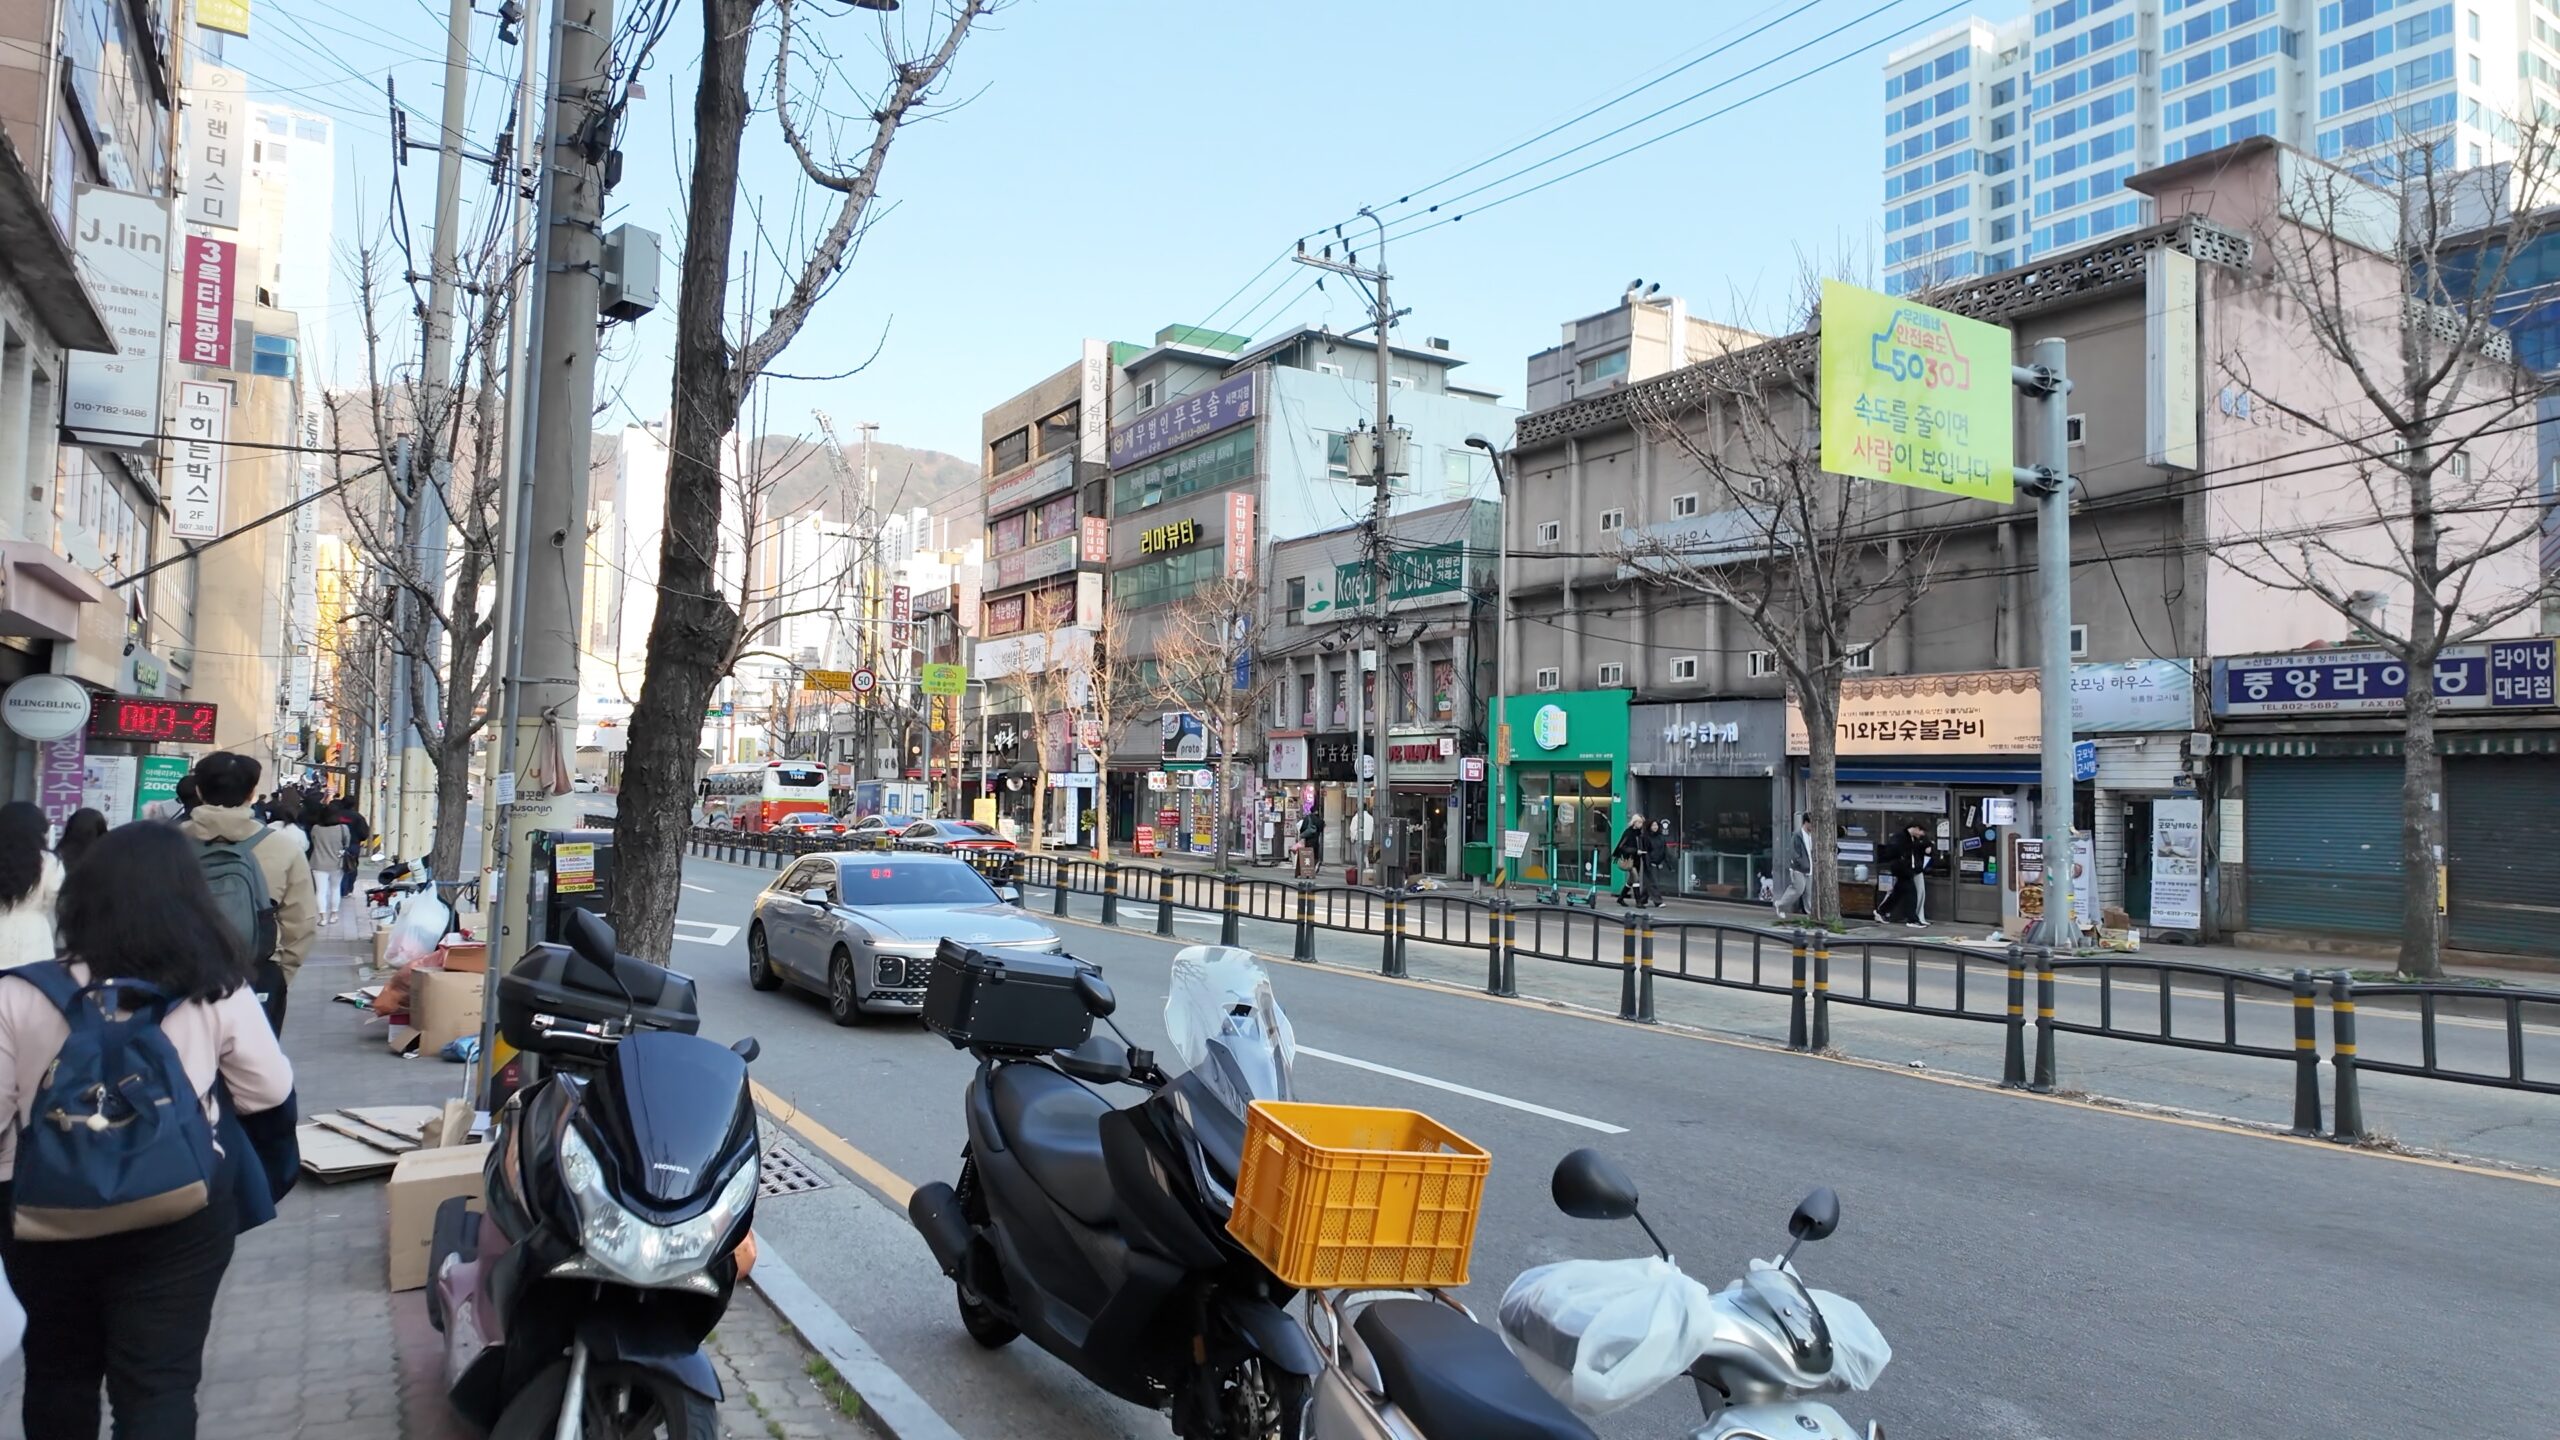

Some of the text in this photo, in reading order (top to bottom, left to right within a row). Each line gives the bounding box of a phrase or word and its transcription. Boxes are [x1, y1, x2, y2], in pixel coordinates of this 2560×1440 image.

[80, 218, 162, 254] J.lin
[1896, 324, 1948, 355] 안전속도
[1892, 349, 1955, 389] 5030
[1125, 412, 1169, 448] 세무법인
[1173, 390, 1221, 431] 푸른솔
[1853, 392, 1969, 447] 속도를 줄이면
[186, 417, 212, 503] 히든박스
[1853, 435, 1991, 486] 사람이 보입니다
[189, 510, 204, 519] 2F
[1141, 518, 1194, 554] 리마뷰티
[1403, 555, 1434, 590] Club
[2495, 647, 2550, 670] 라이닝
[858, 676, 870, 686] 50
[2111, 675, 2154, 690] 하우스
[2496, 676, 2551, 699] 대리점
[9, 699, 82, 710] BLINGBLING
[1664, 721, 1739, 749] 기억하개
[1838, 719, 1985, 741] 기와집숯불갈비
[1181, 744, 1200, 755] proto
[653, 1163, 690, 1175] HONDA
